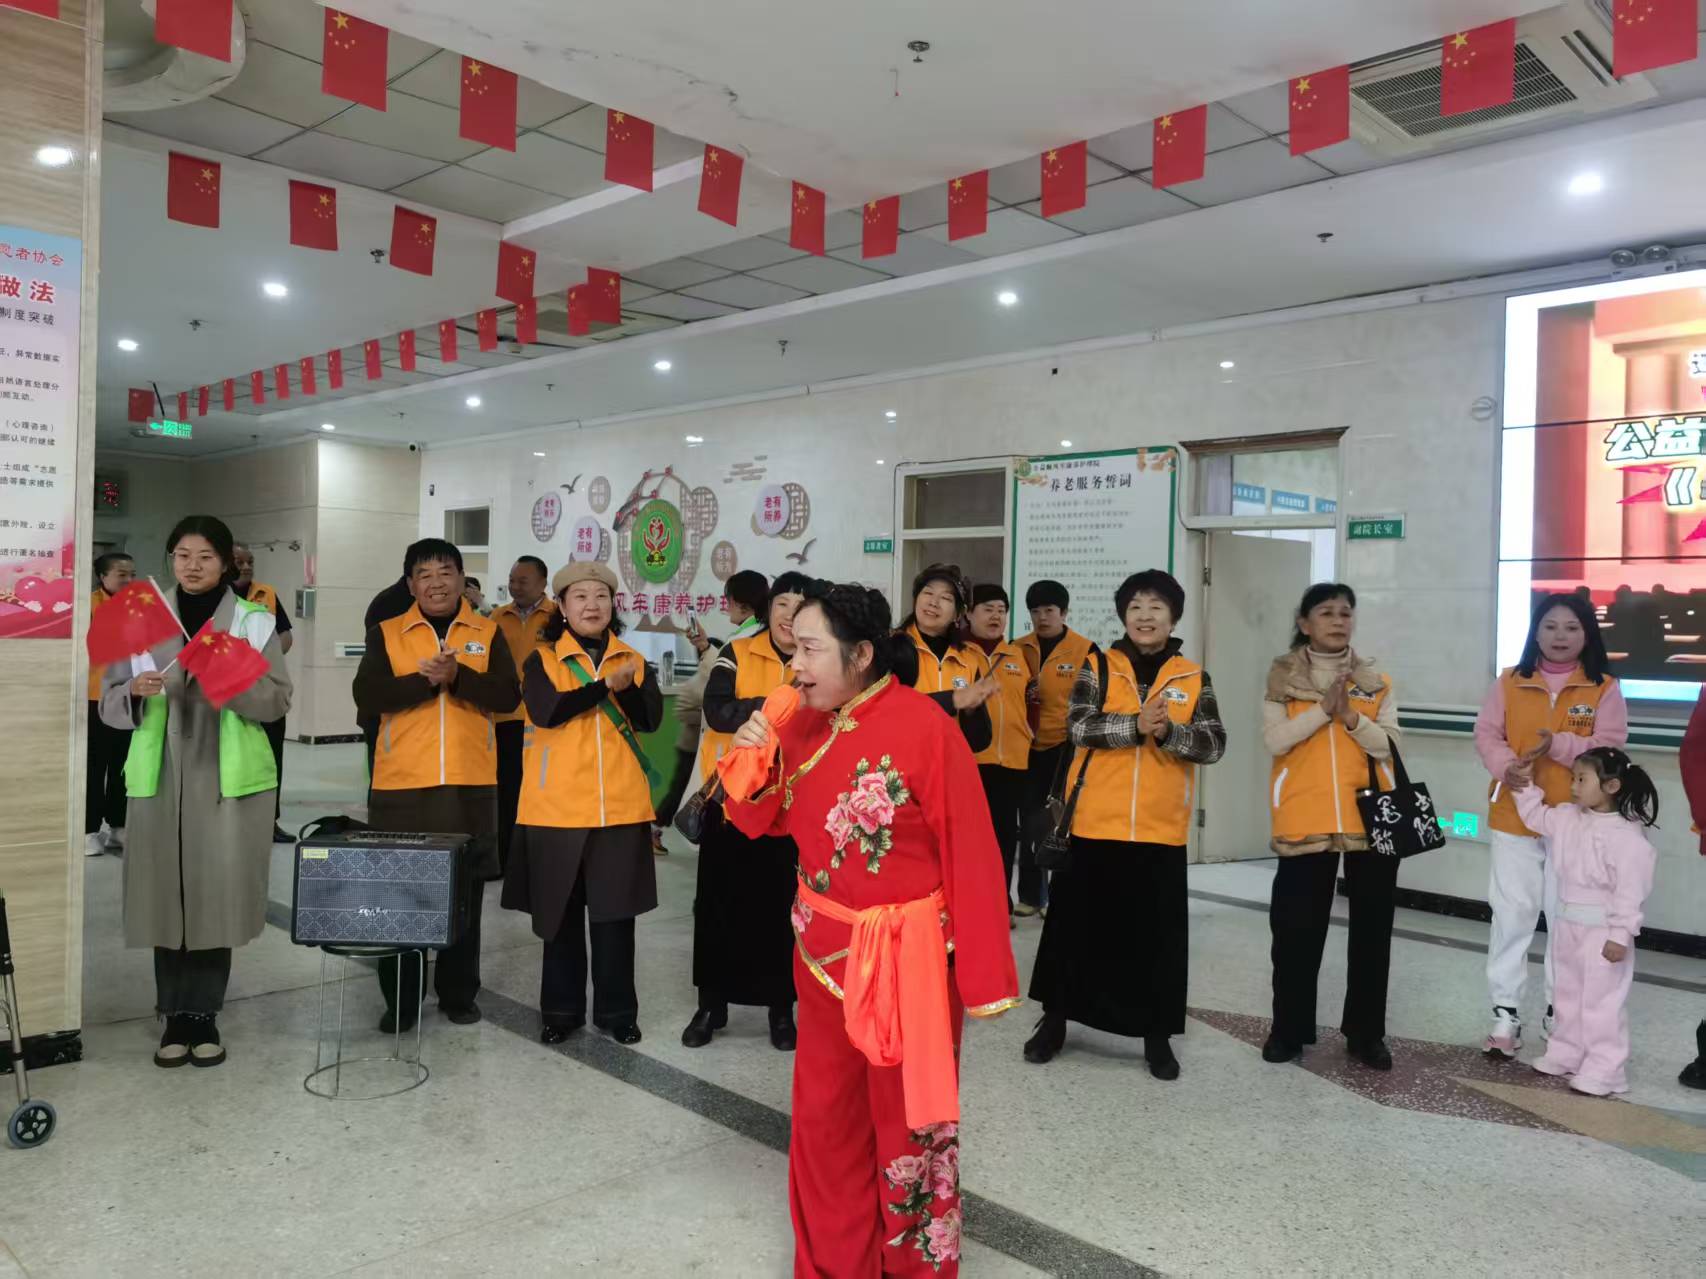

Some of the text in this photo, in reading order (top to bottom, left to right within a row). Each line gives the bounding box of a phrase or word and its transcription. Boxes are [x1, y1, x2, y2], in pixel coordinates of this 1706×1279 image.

[0, 275, 54, 303] 做法
[0, 391, 34, 401] 频互动。
[1604, 416, 1706, 461] 公益
[1051, 472, 1132, 492] 养老服务誓词
